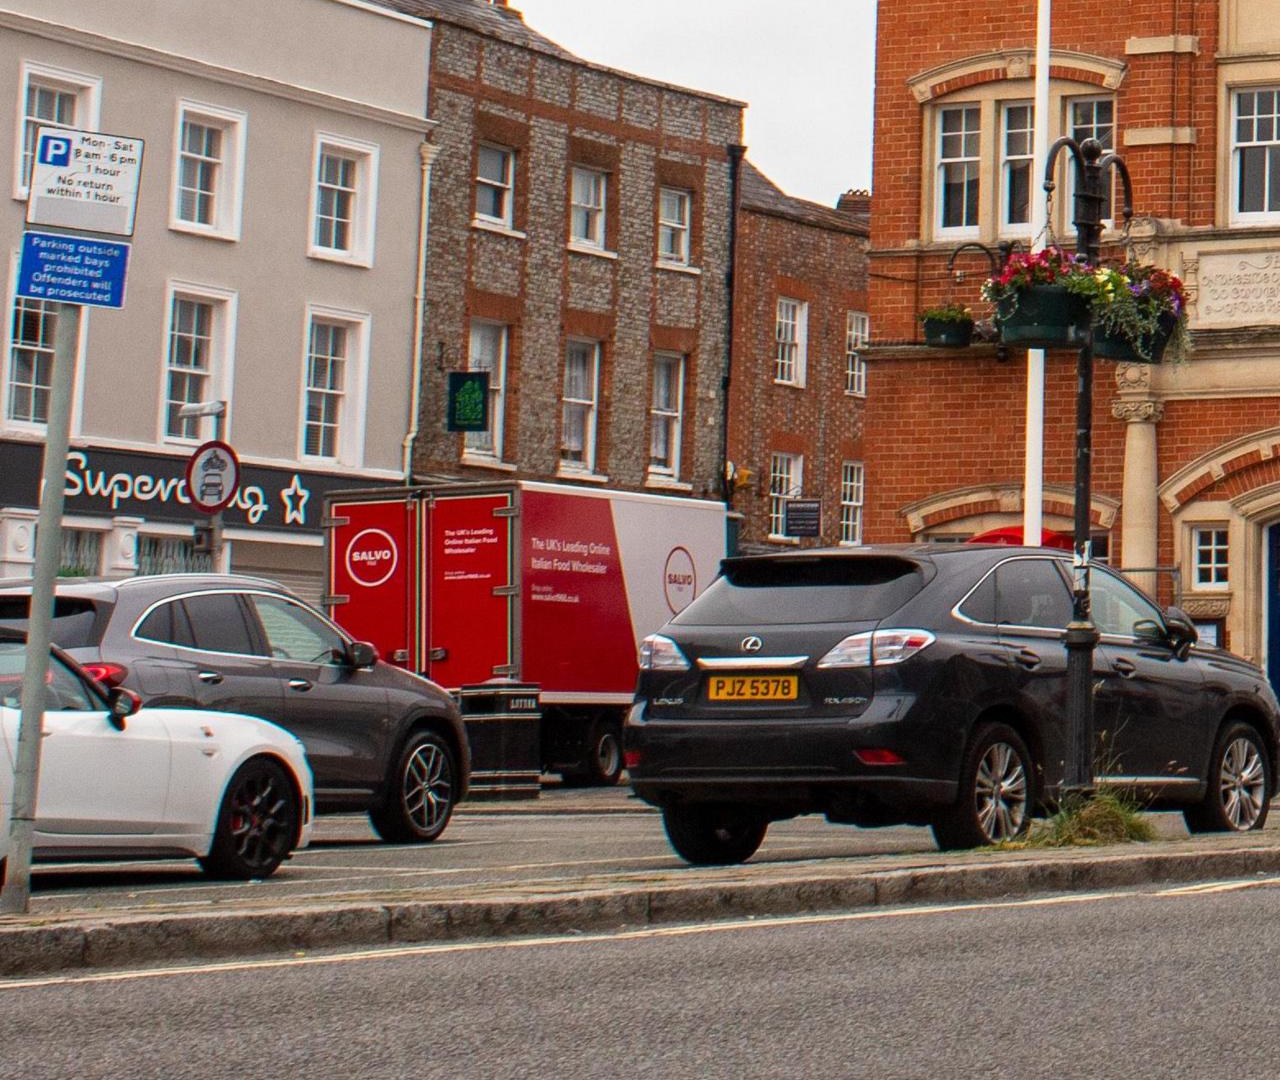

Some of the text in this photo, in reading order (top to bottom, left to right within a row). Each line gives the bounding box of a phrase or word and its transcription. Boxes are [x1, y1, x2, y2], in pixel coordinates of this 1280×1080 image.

[45, 139, 68, 162] P
[95, 166, 121, 176] hour
[57, 176, 113, 191] No return
[47, 187, 82, 198] within
[95, 192, 120, 203] hour
[32, 237, 120, 257] Parking outside
[38, 251, 110, 267] marked bays
[43, 263, 103, 277] prohibited
[32, 272, 112, 291] Offenders will
[29, 283, 111, 302] be prosecuted
[531, 537, 611, 556] The UK's Leading Online
[352, 550, 391, 561] SALVO
[531, 557, 552, 570] Italian
[553, 558, 570, 571] Food
[668, 573, 693, 585] SALVO
[715, 679, 791, 696] PJZ 5378
